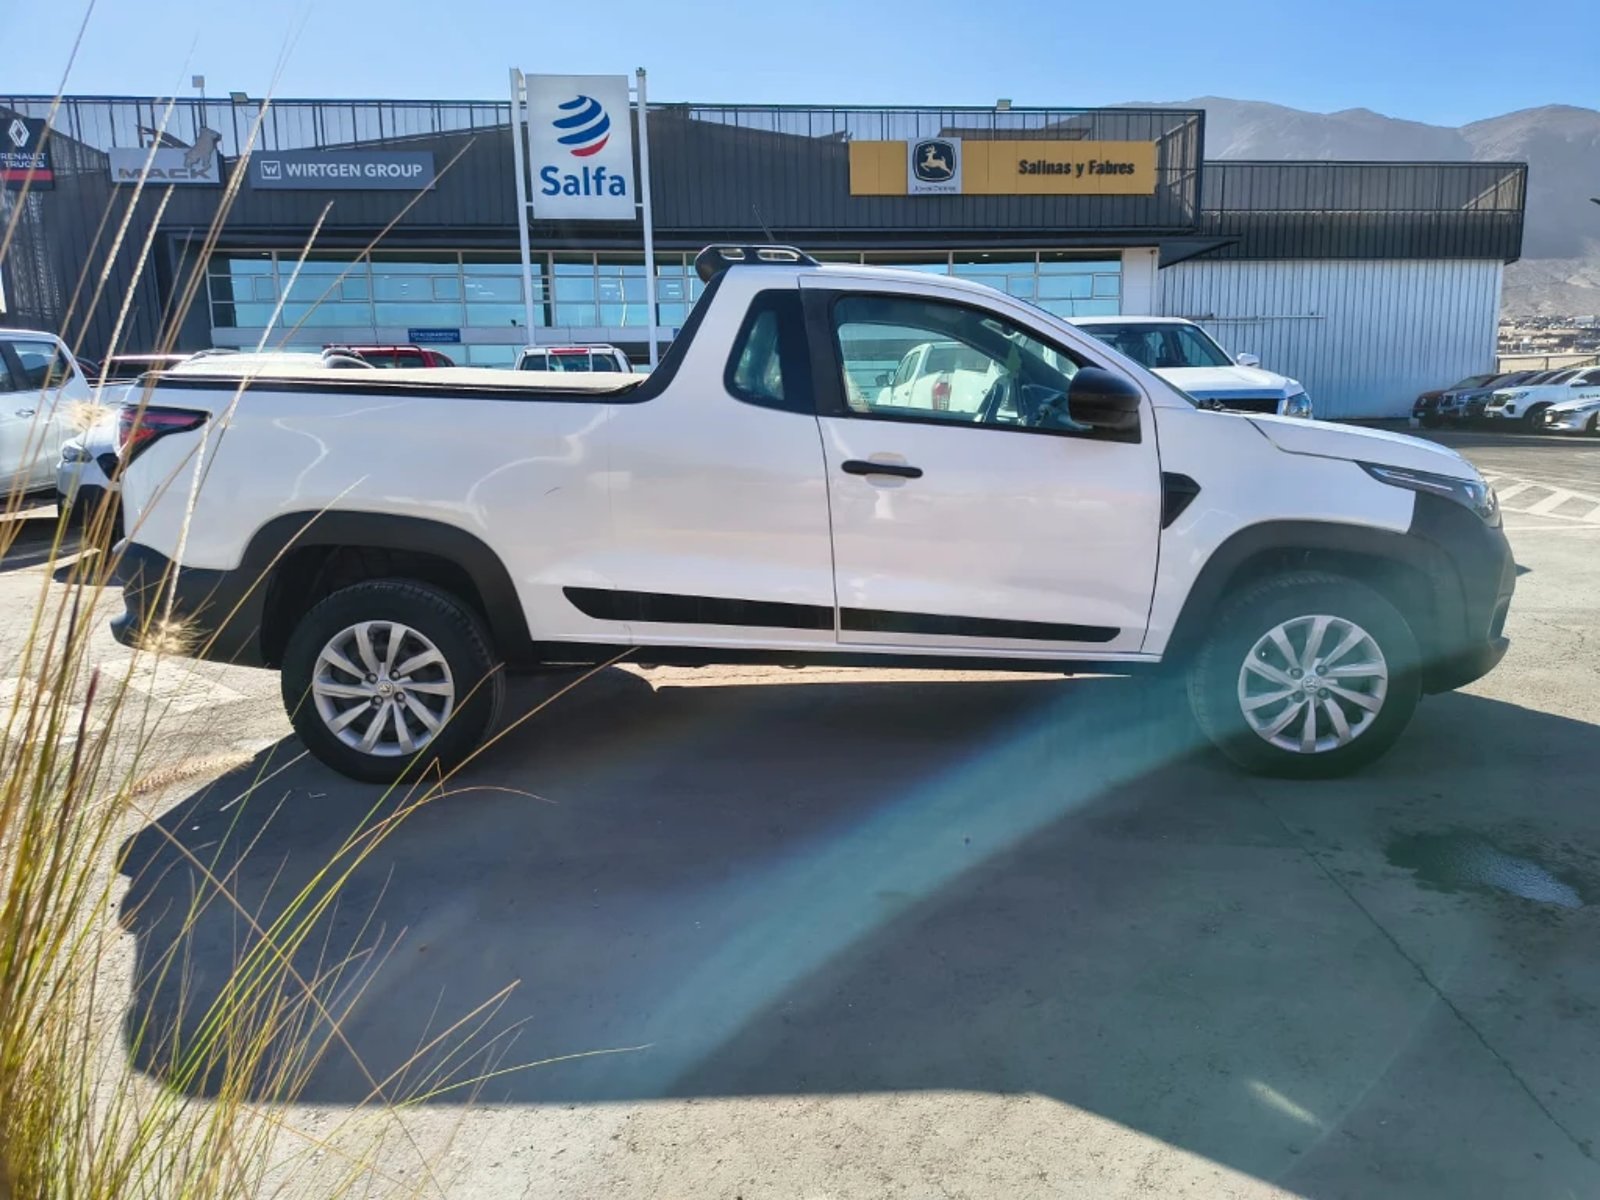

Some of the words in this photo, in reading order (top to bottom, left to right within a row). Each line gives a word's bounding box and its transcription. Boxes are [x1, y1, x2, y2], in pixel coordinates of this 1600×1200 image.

[118, 168, 211, 179] MACK
[286, 163, 361, 177] WIRTGEN
[364, 163, 423, 177] GROUP
[1018, 159, 1072, 175] Salinas
[1075, 163, 1085, 179] y
[1088, 159, 1135, 175] Fabres
[540, 165, 626, 196] Salfa
